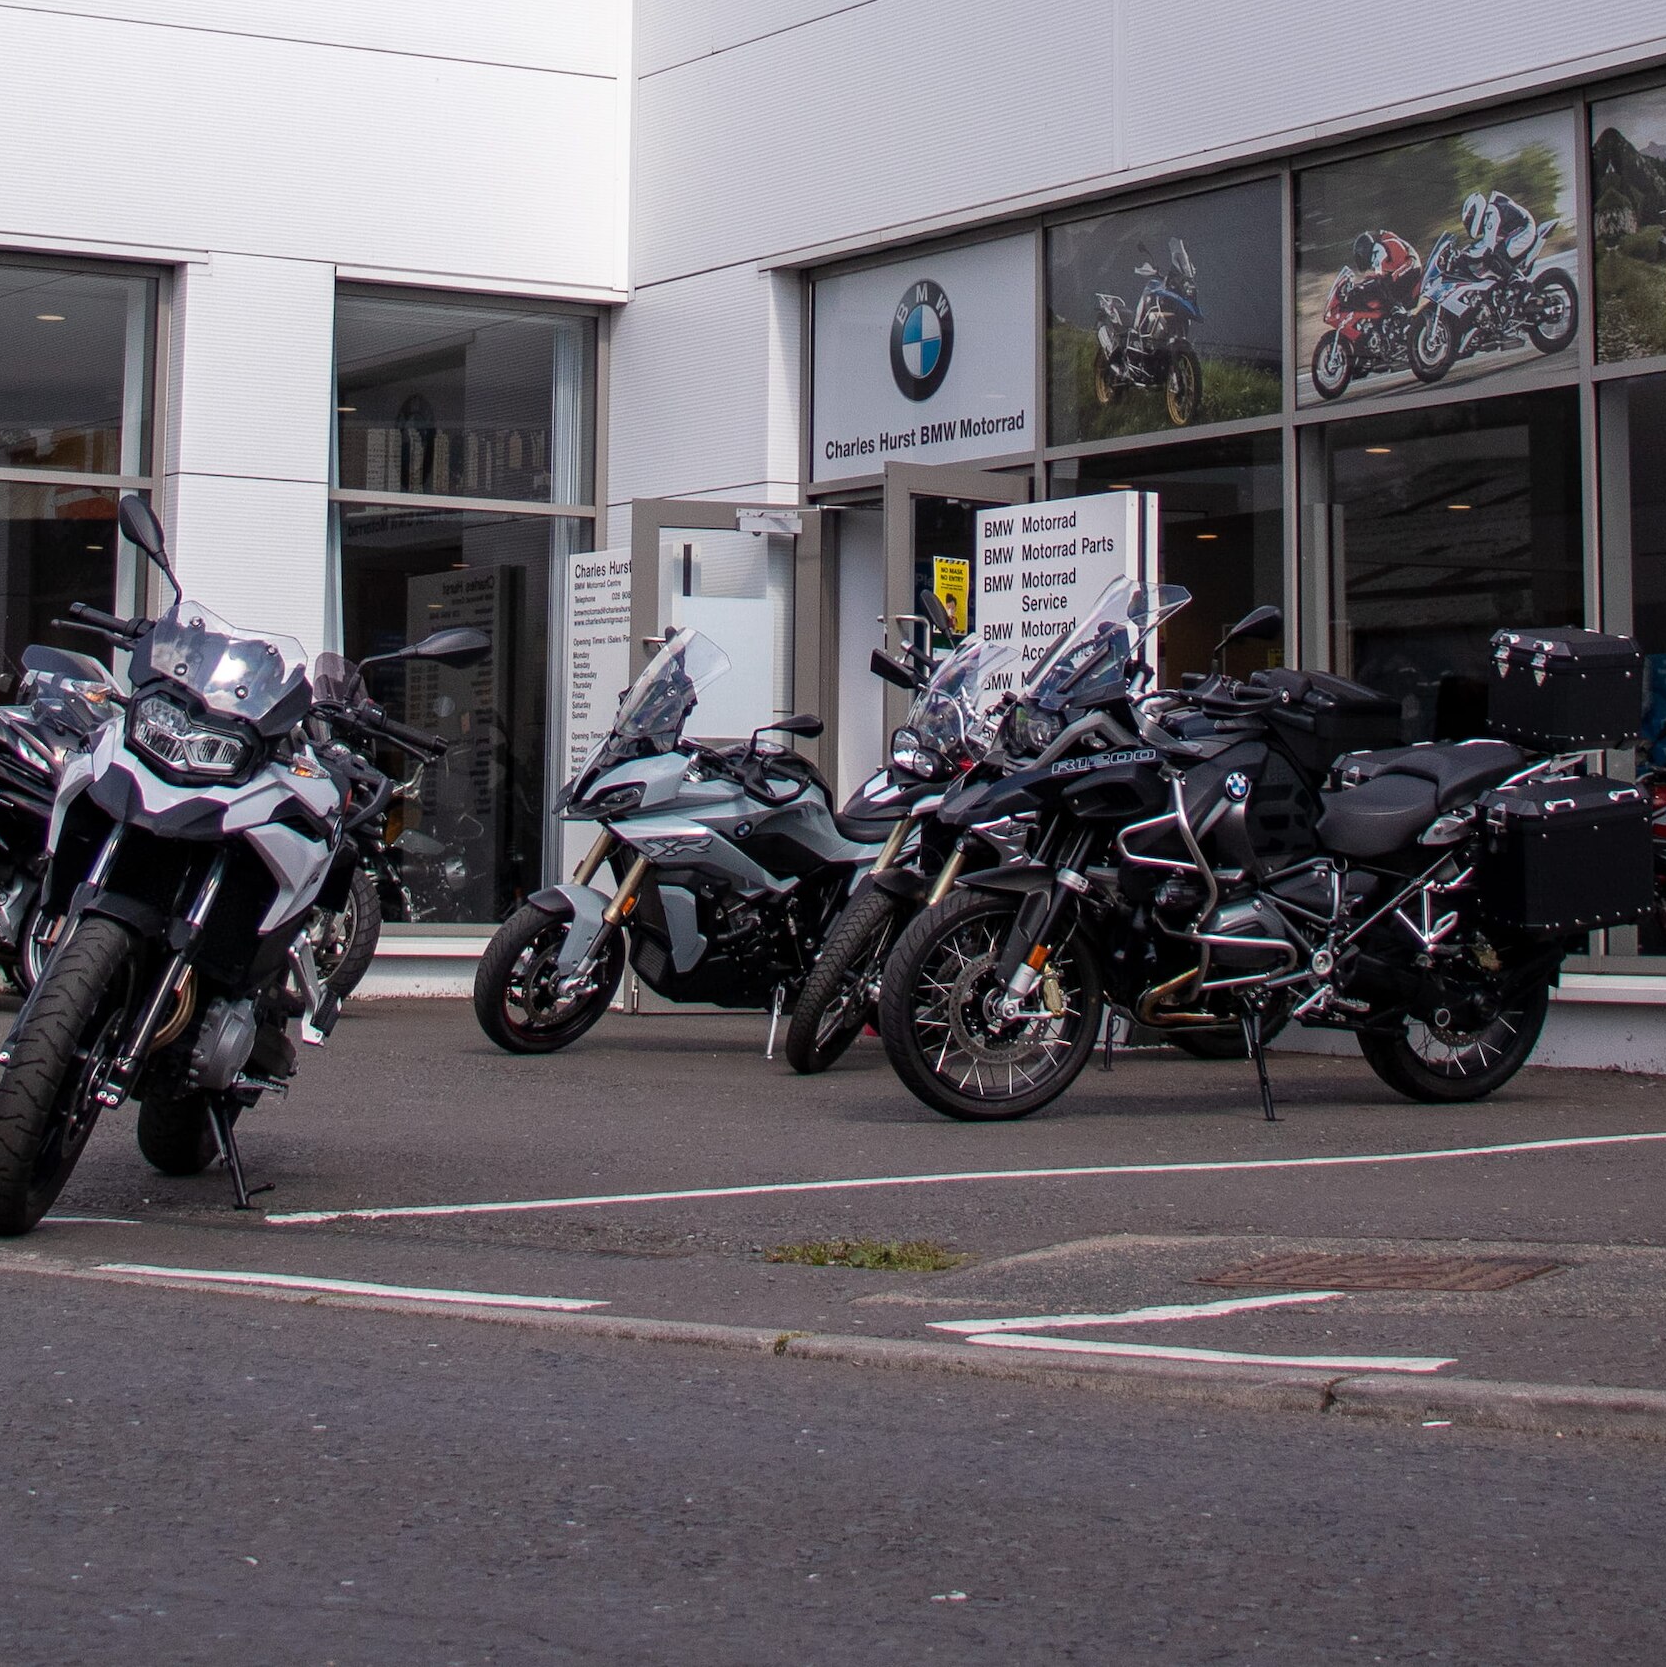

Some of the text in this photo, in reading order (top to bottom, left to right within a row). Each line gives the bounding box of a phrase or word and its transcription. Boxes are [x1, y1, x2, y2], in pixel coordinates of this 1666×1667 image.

[895, 282, 950, 326] BMW
[825, 409, 1025, 460] Charles Hurst BMW Motorrad
[984, 511, 1076, 538] BMW Motorrad
[984, 536, 1114, 566] BMW Motorrad Parts
[574, 560, 632, 579] Charles Hurst
[984, 574, 1013, 593] BMW
[1021, 567, 1076, 589] Motorrad
[1021, 593, 1068, 612] Service
[983, 617, 1076, 641] BMW Motorrad
[1051, 748, 1157, 774] R1200
